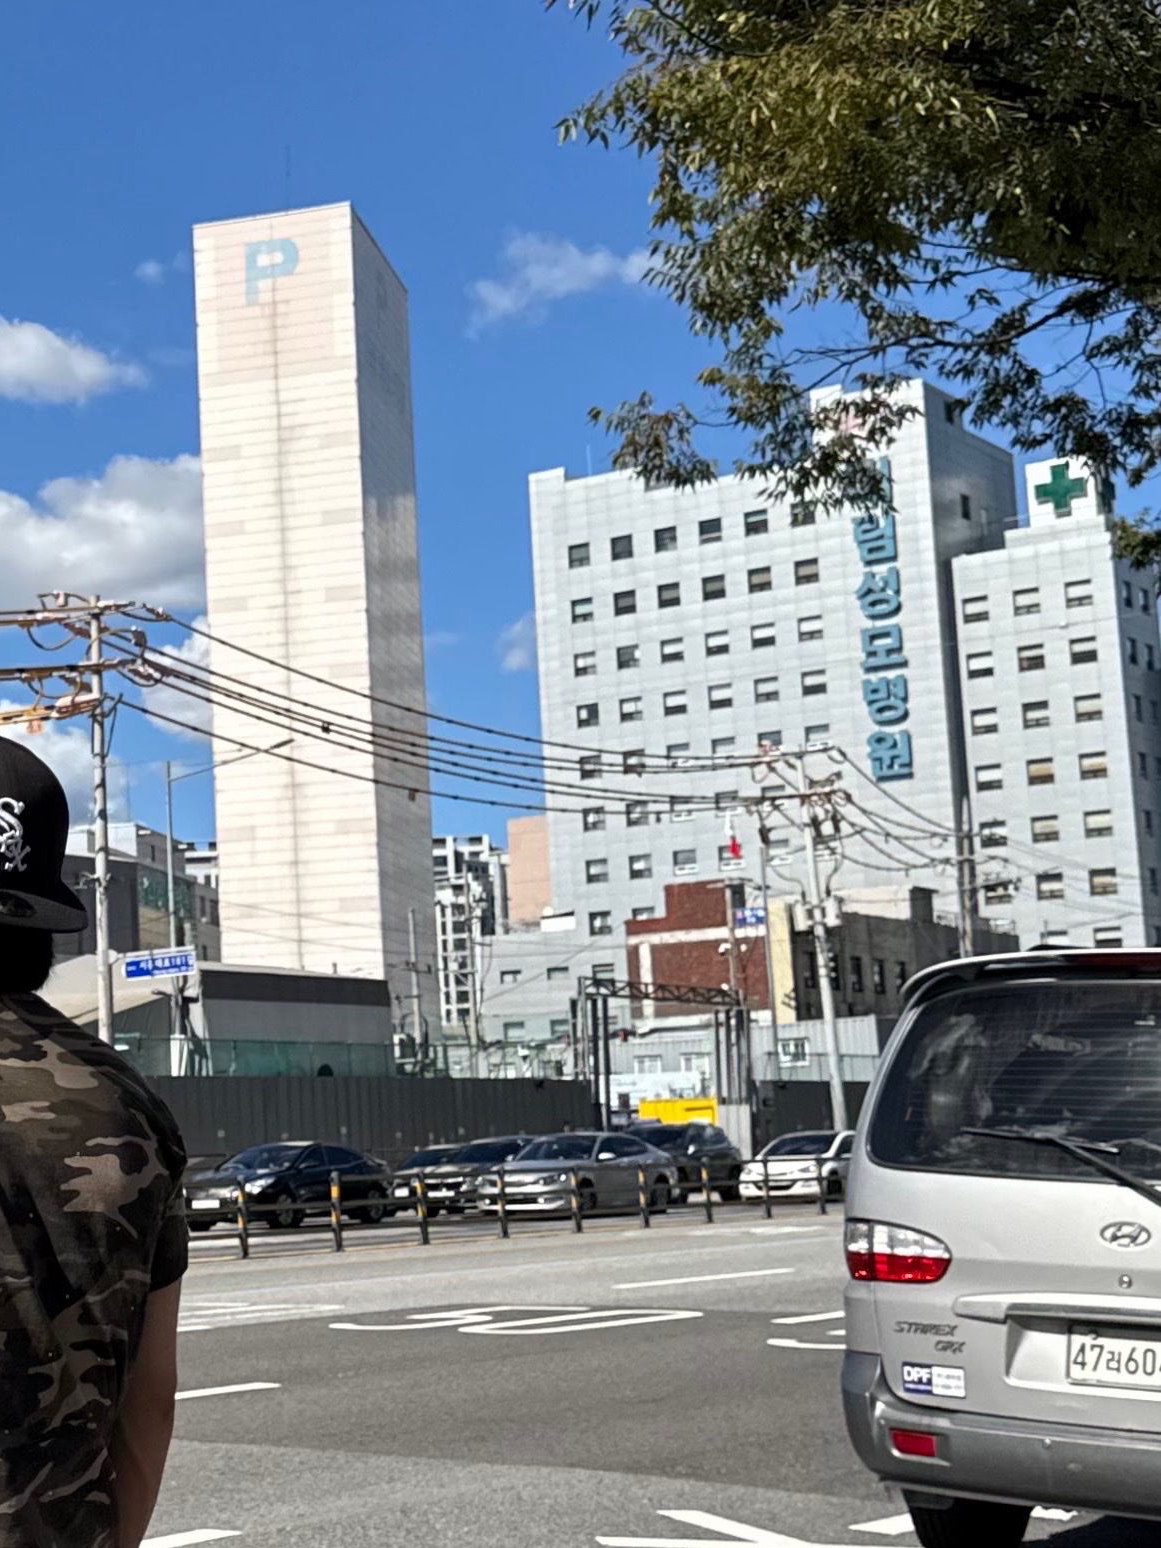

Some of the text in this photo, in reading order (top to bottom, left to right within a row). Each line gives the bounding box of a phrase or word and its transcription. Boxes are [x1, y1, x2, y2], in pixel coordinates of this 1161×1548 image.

[243, 238, 300, 307] P
[894, 1320, 958, 1337] STAREX
[1072, 1341, 1161, 1377] 47러60
[903, 1366, 932, 1383] DPF
